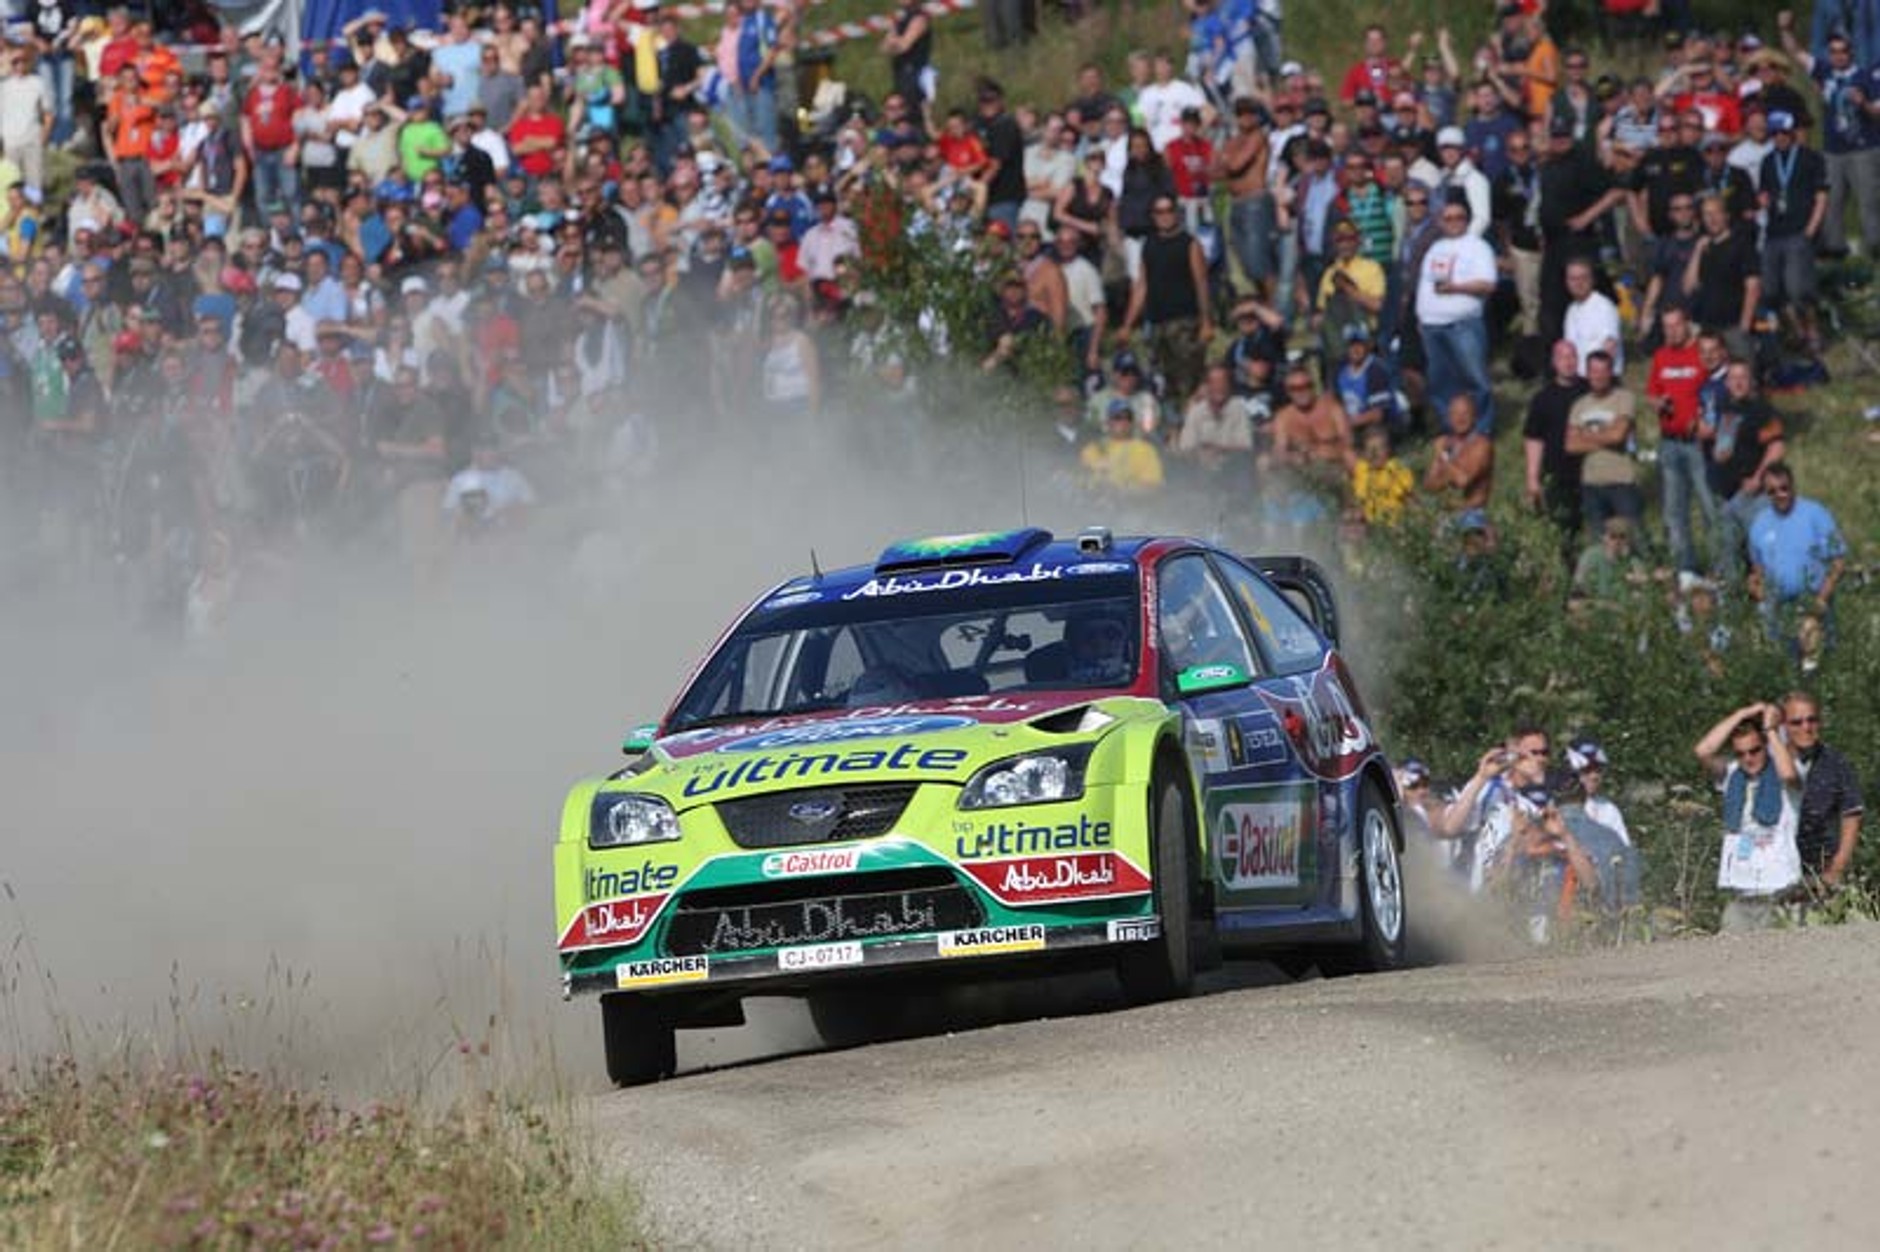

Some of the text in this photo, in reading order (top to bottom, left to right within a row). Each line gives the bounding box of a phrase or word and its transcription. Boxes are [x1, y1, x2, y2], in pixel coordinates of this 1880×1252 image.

[842, 578, 938, 600] Abu
[940, 563, 1060, 589] Dhabi
[683, 744, 968, 799] ultimate
[956, 814, 1111, 858] ultimate
[584, 860, 678, 899] ltimate
[785, 853, 854, 873] Castrol
[999, 856, 1115, 891] Abu Dhabi
[702, 893, 936, 950] Abu Dhabi
